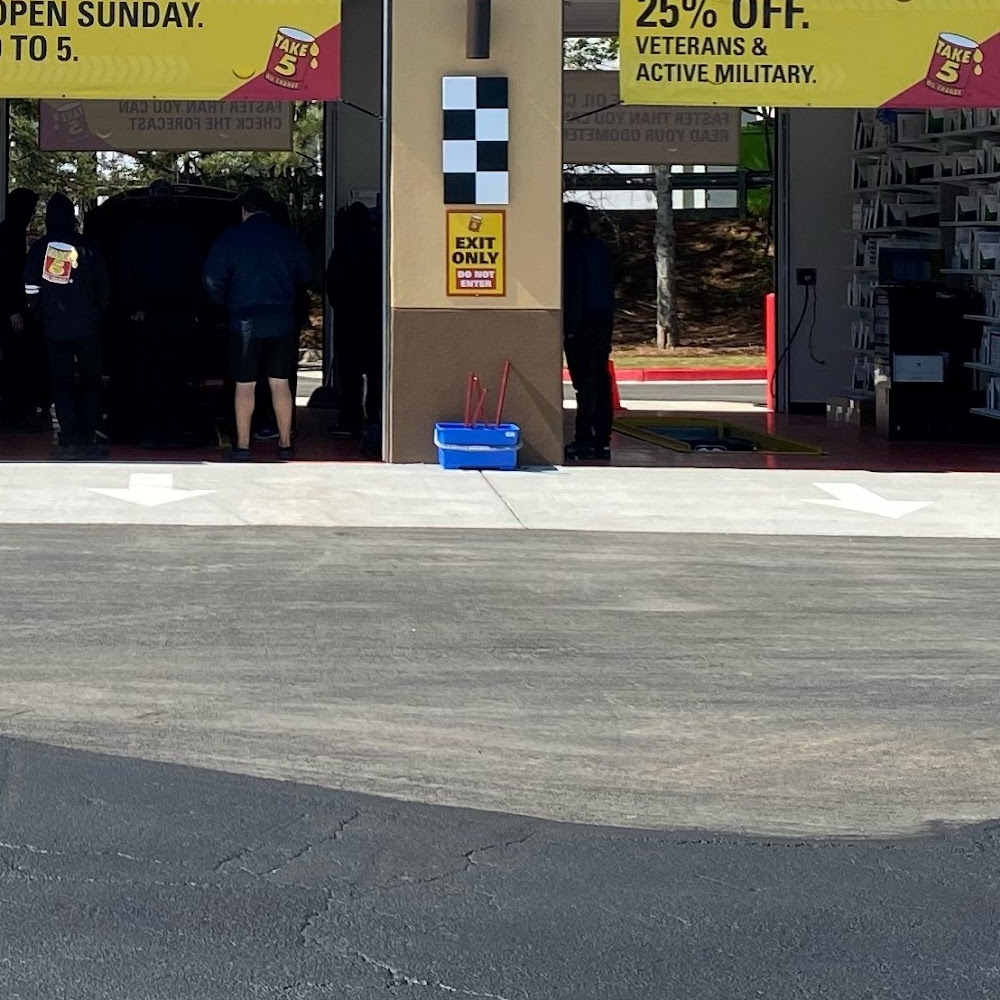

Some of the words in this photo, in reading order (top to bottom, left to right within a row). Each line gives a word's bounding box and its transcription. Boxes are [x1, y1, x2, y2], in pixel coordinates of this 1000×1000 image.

[77, 0, 204, 28] SUNDAY.
[9, 34, 48, 62] TO
[56, 36, 79, 62] 5.
[274, 33, 309, 58] TAKE
[635, 35, 746, 56] VETERANS
[751, 37, 769, 57] &
[936, 39, 972, 64] TAKE
[273, 53, 298, 77] 5
[635, 62, 709, 82] ACTIVE
[715, 64, 818, 84] MILITARY.
[935, 59, 960, 84] 5
[455, 236, 496, 249] EXIT
[452, 251, 500, 264] ONLY
[457, 270, 472, 279] DO
[474, 270, 496, 279] NOT
[460, 280, 493, 288] ENTER
